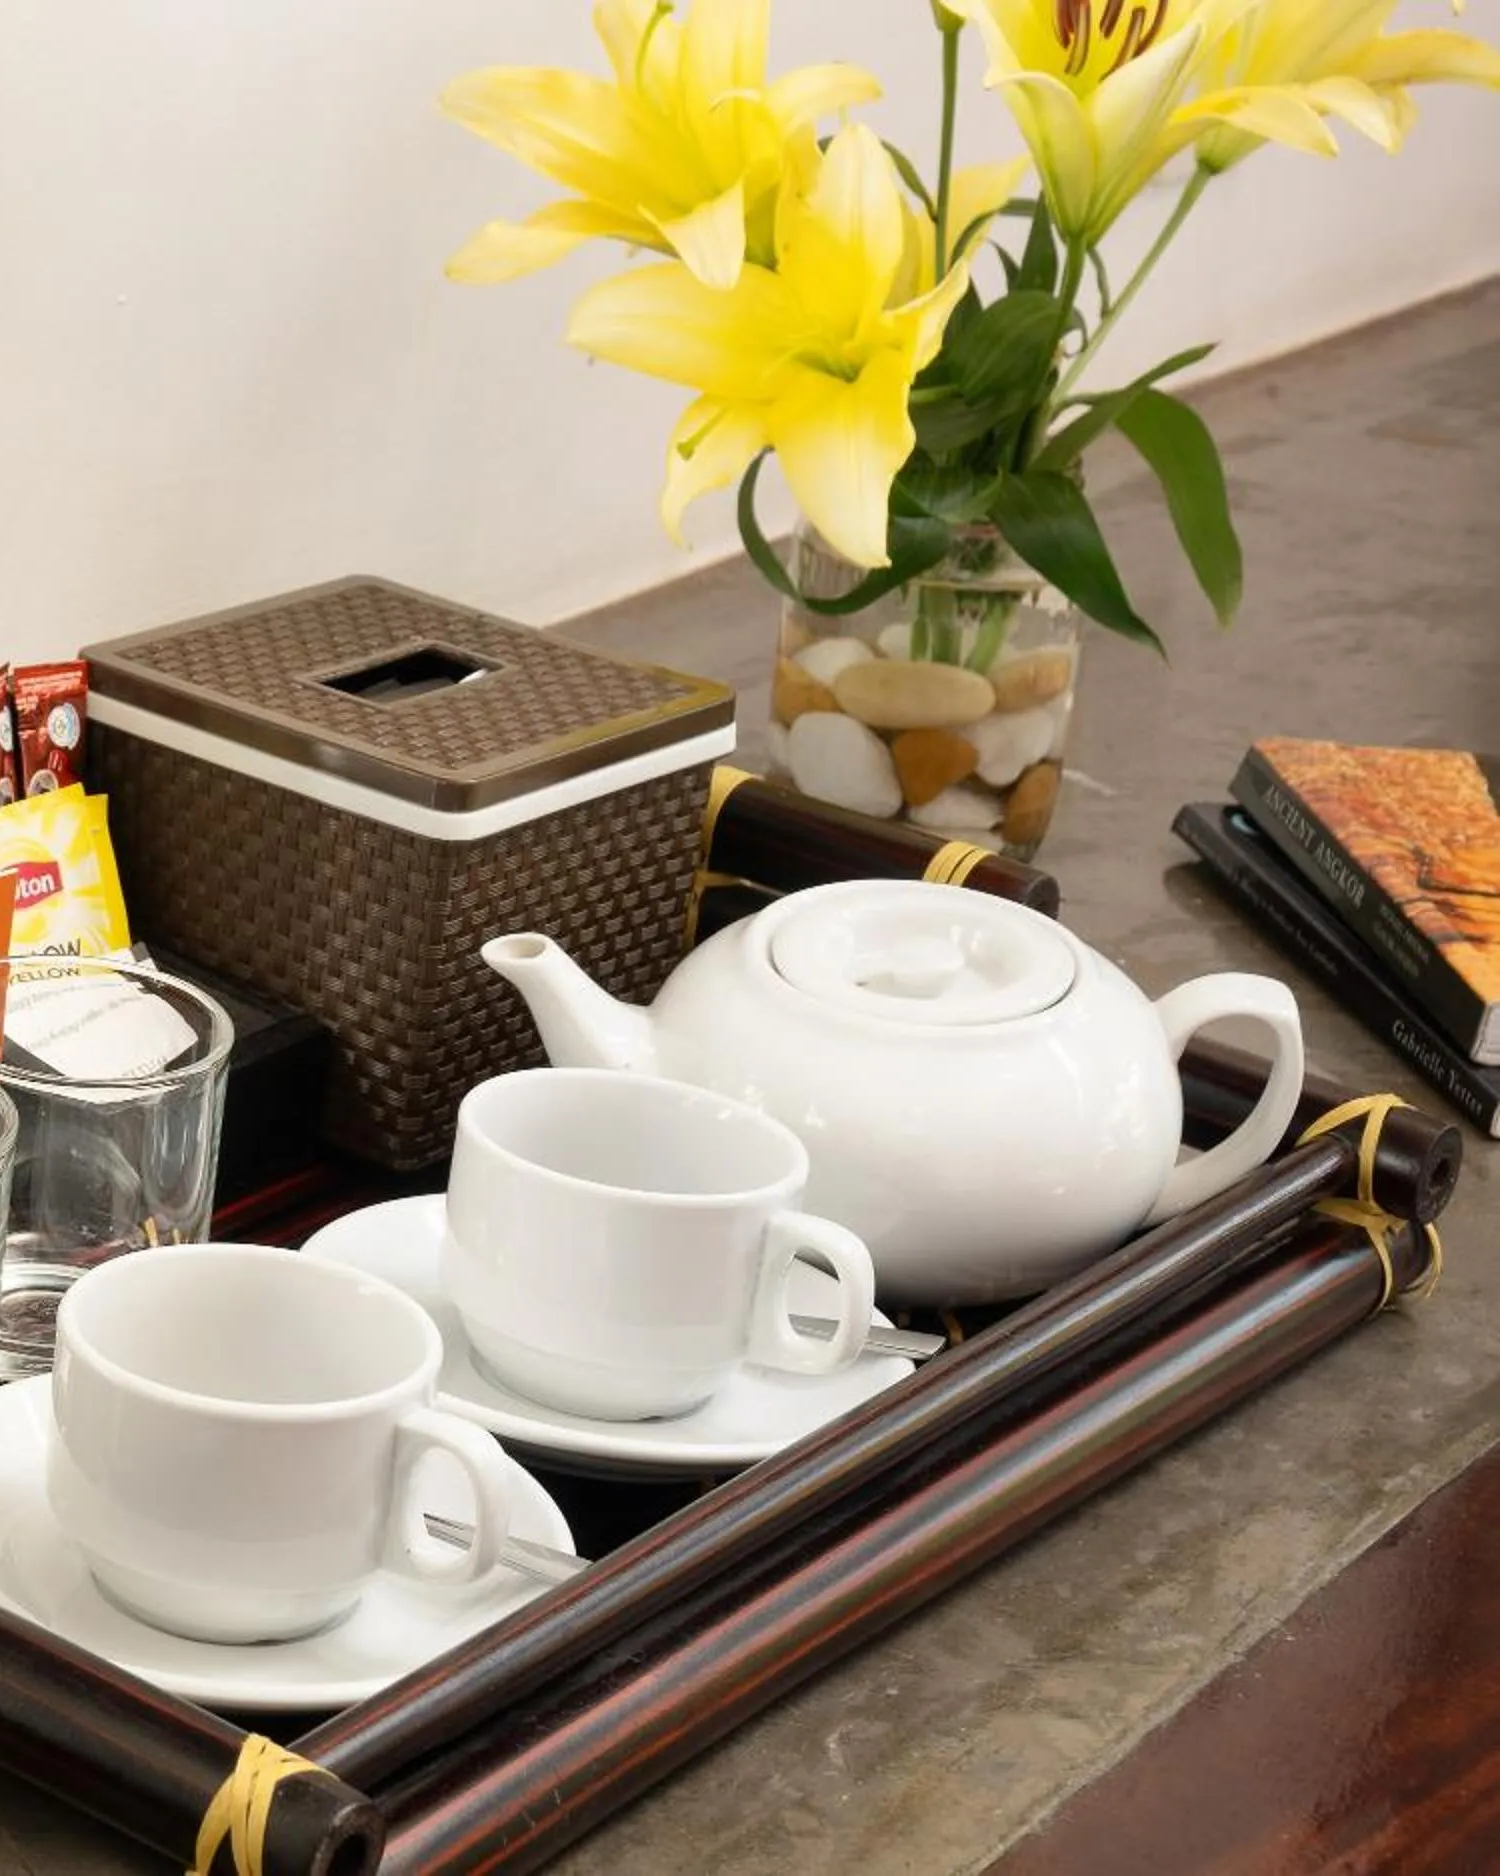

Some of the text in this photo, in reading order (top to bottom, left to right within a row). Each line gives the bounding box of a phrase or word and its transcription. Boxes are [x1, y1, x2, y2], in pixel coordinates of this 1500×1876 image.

[1265, 784, 1317, 849] ANCIENT
[1314, 841, 1366, 910] ANGKOR
[16, 872, 56, 899] ton
